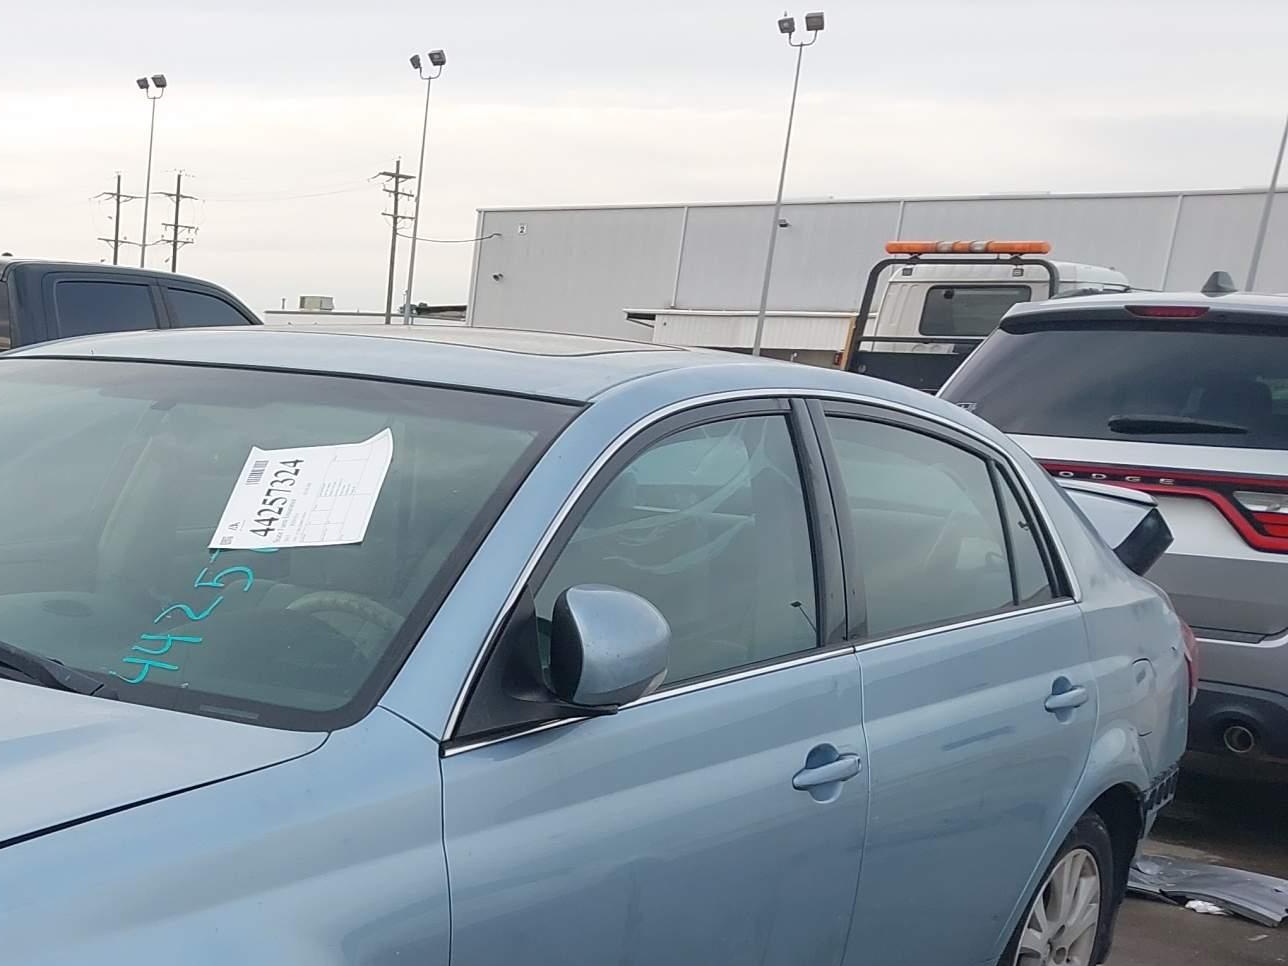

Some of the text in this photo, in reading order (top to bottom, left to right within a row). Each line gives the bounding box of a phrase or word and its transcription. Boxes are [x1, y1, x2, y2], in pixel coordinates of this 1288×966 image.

[249, 459, 305, 538] 44257324
[1058, 471, 1175, 486] ODGE
[109, 548, 279, 684] 4425
